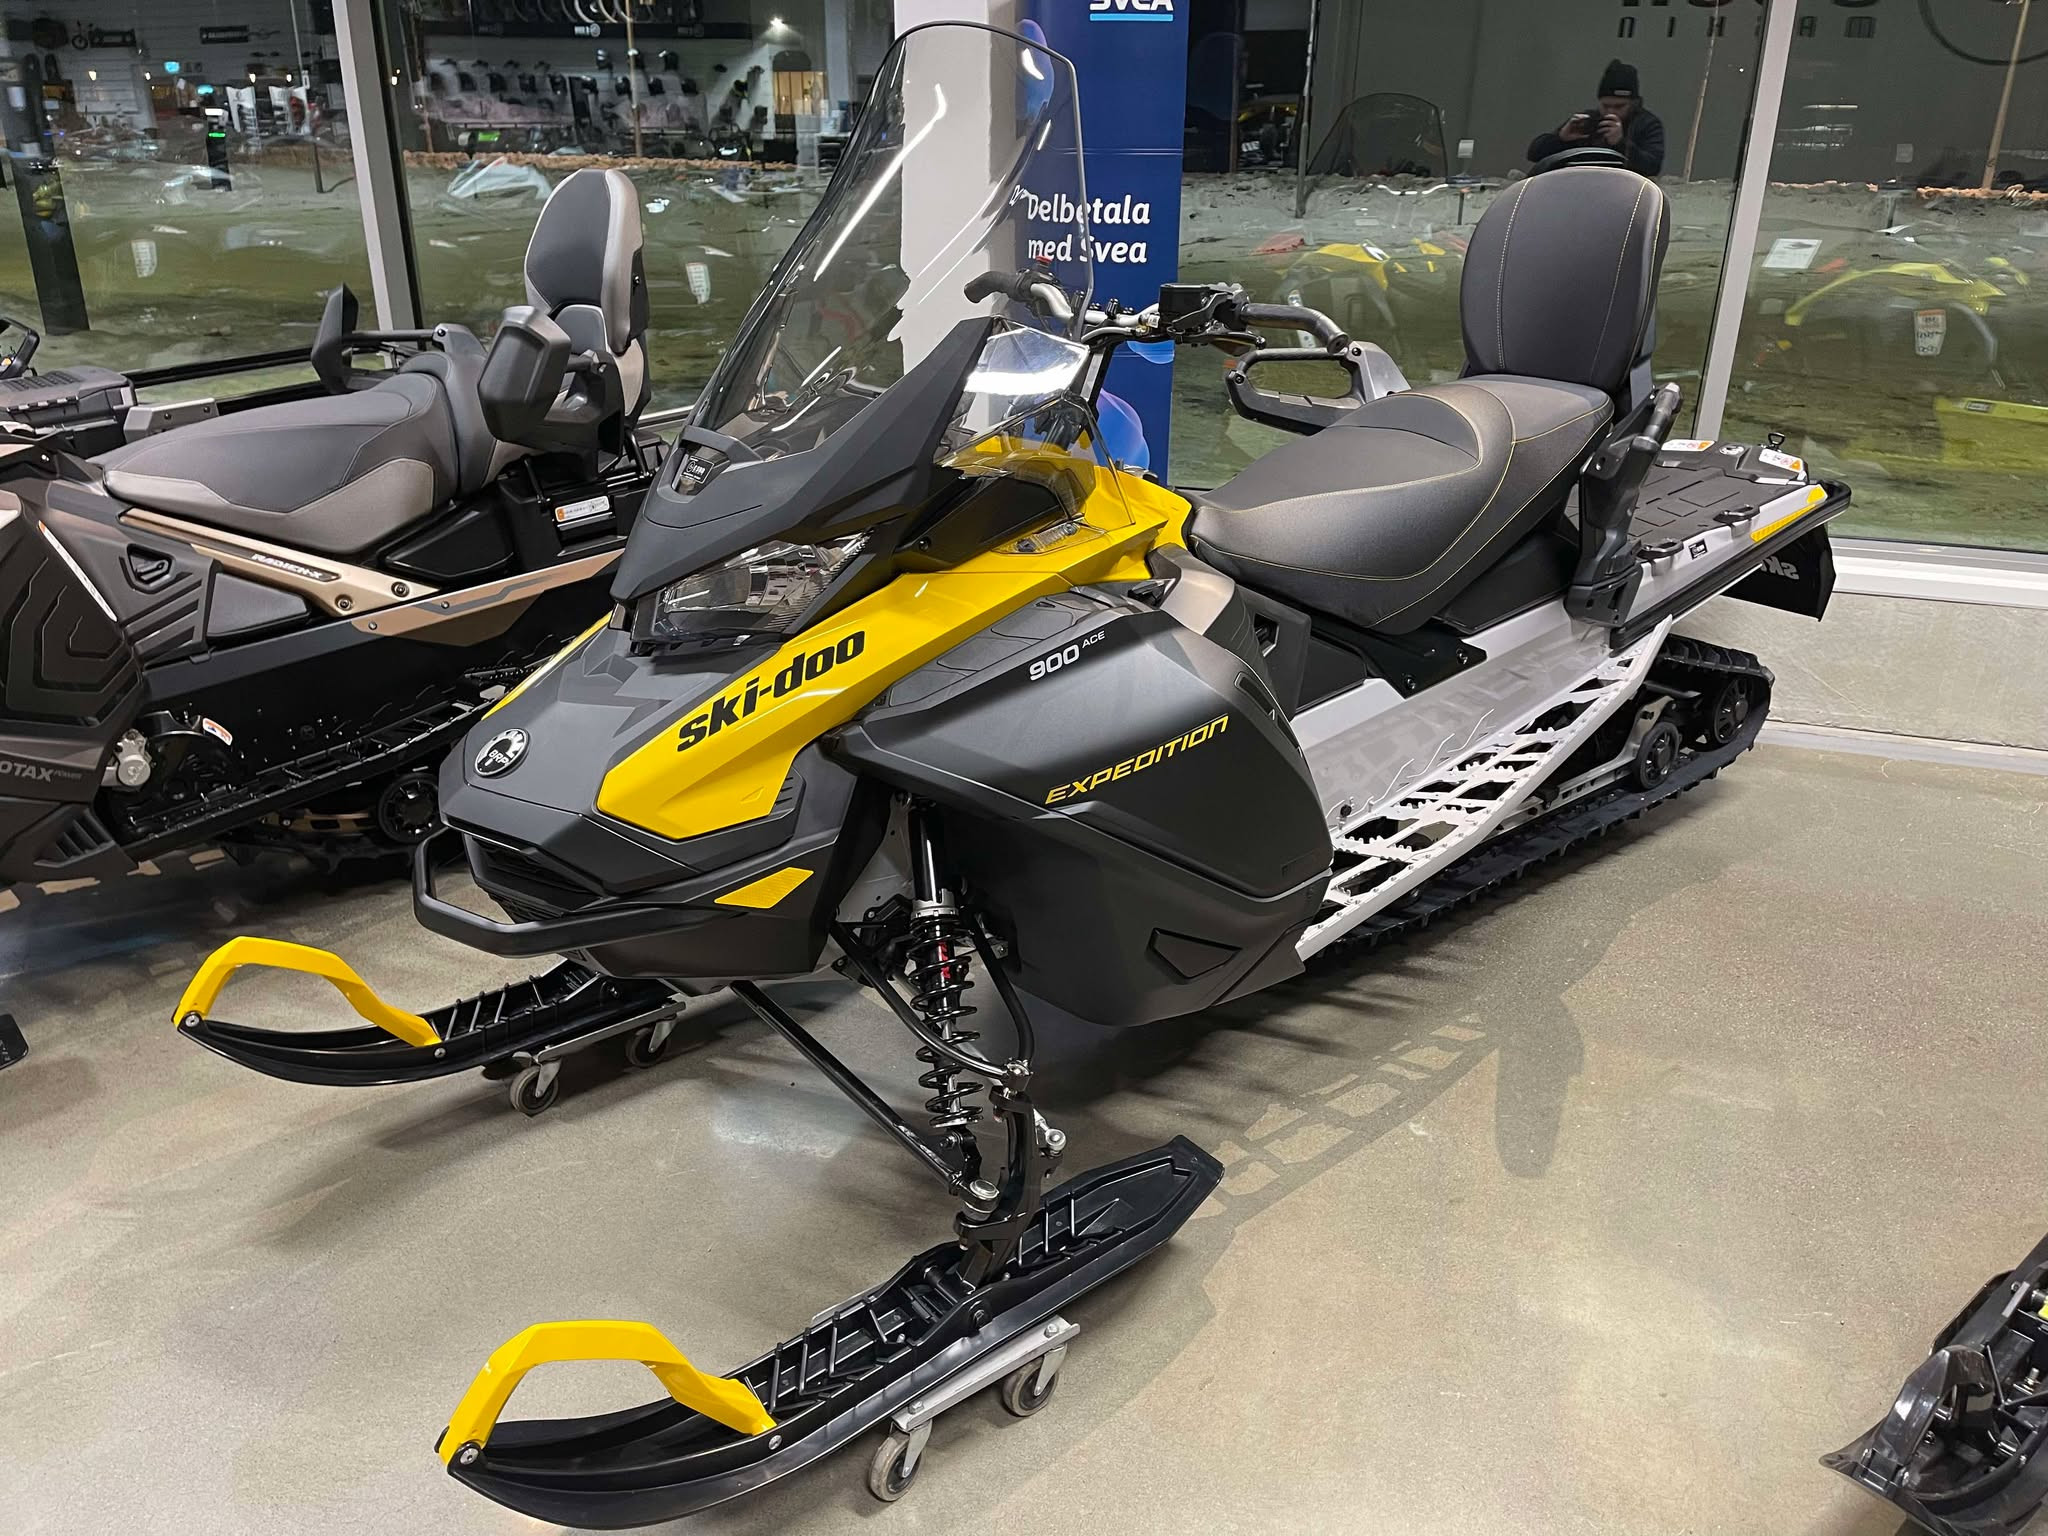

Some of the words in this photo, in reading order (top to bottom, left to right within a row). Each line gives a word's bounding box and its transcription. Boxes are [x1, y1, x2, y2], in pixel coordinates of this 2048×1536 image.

[1027, 193, 1150, 225] Delbetala
[1028, 234, 1072, 262] med
[1079, 236, 1148, 264] Svea
[1029, 644, 1080, 681] 900
[1081, 630, 1106, 649] ACE
[488, 749, 510, 765] BRP
[1045, 715, 1229, 805] EXPEDITION
